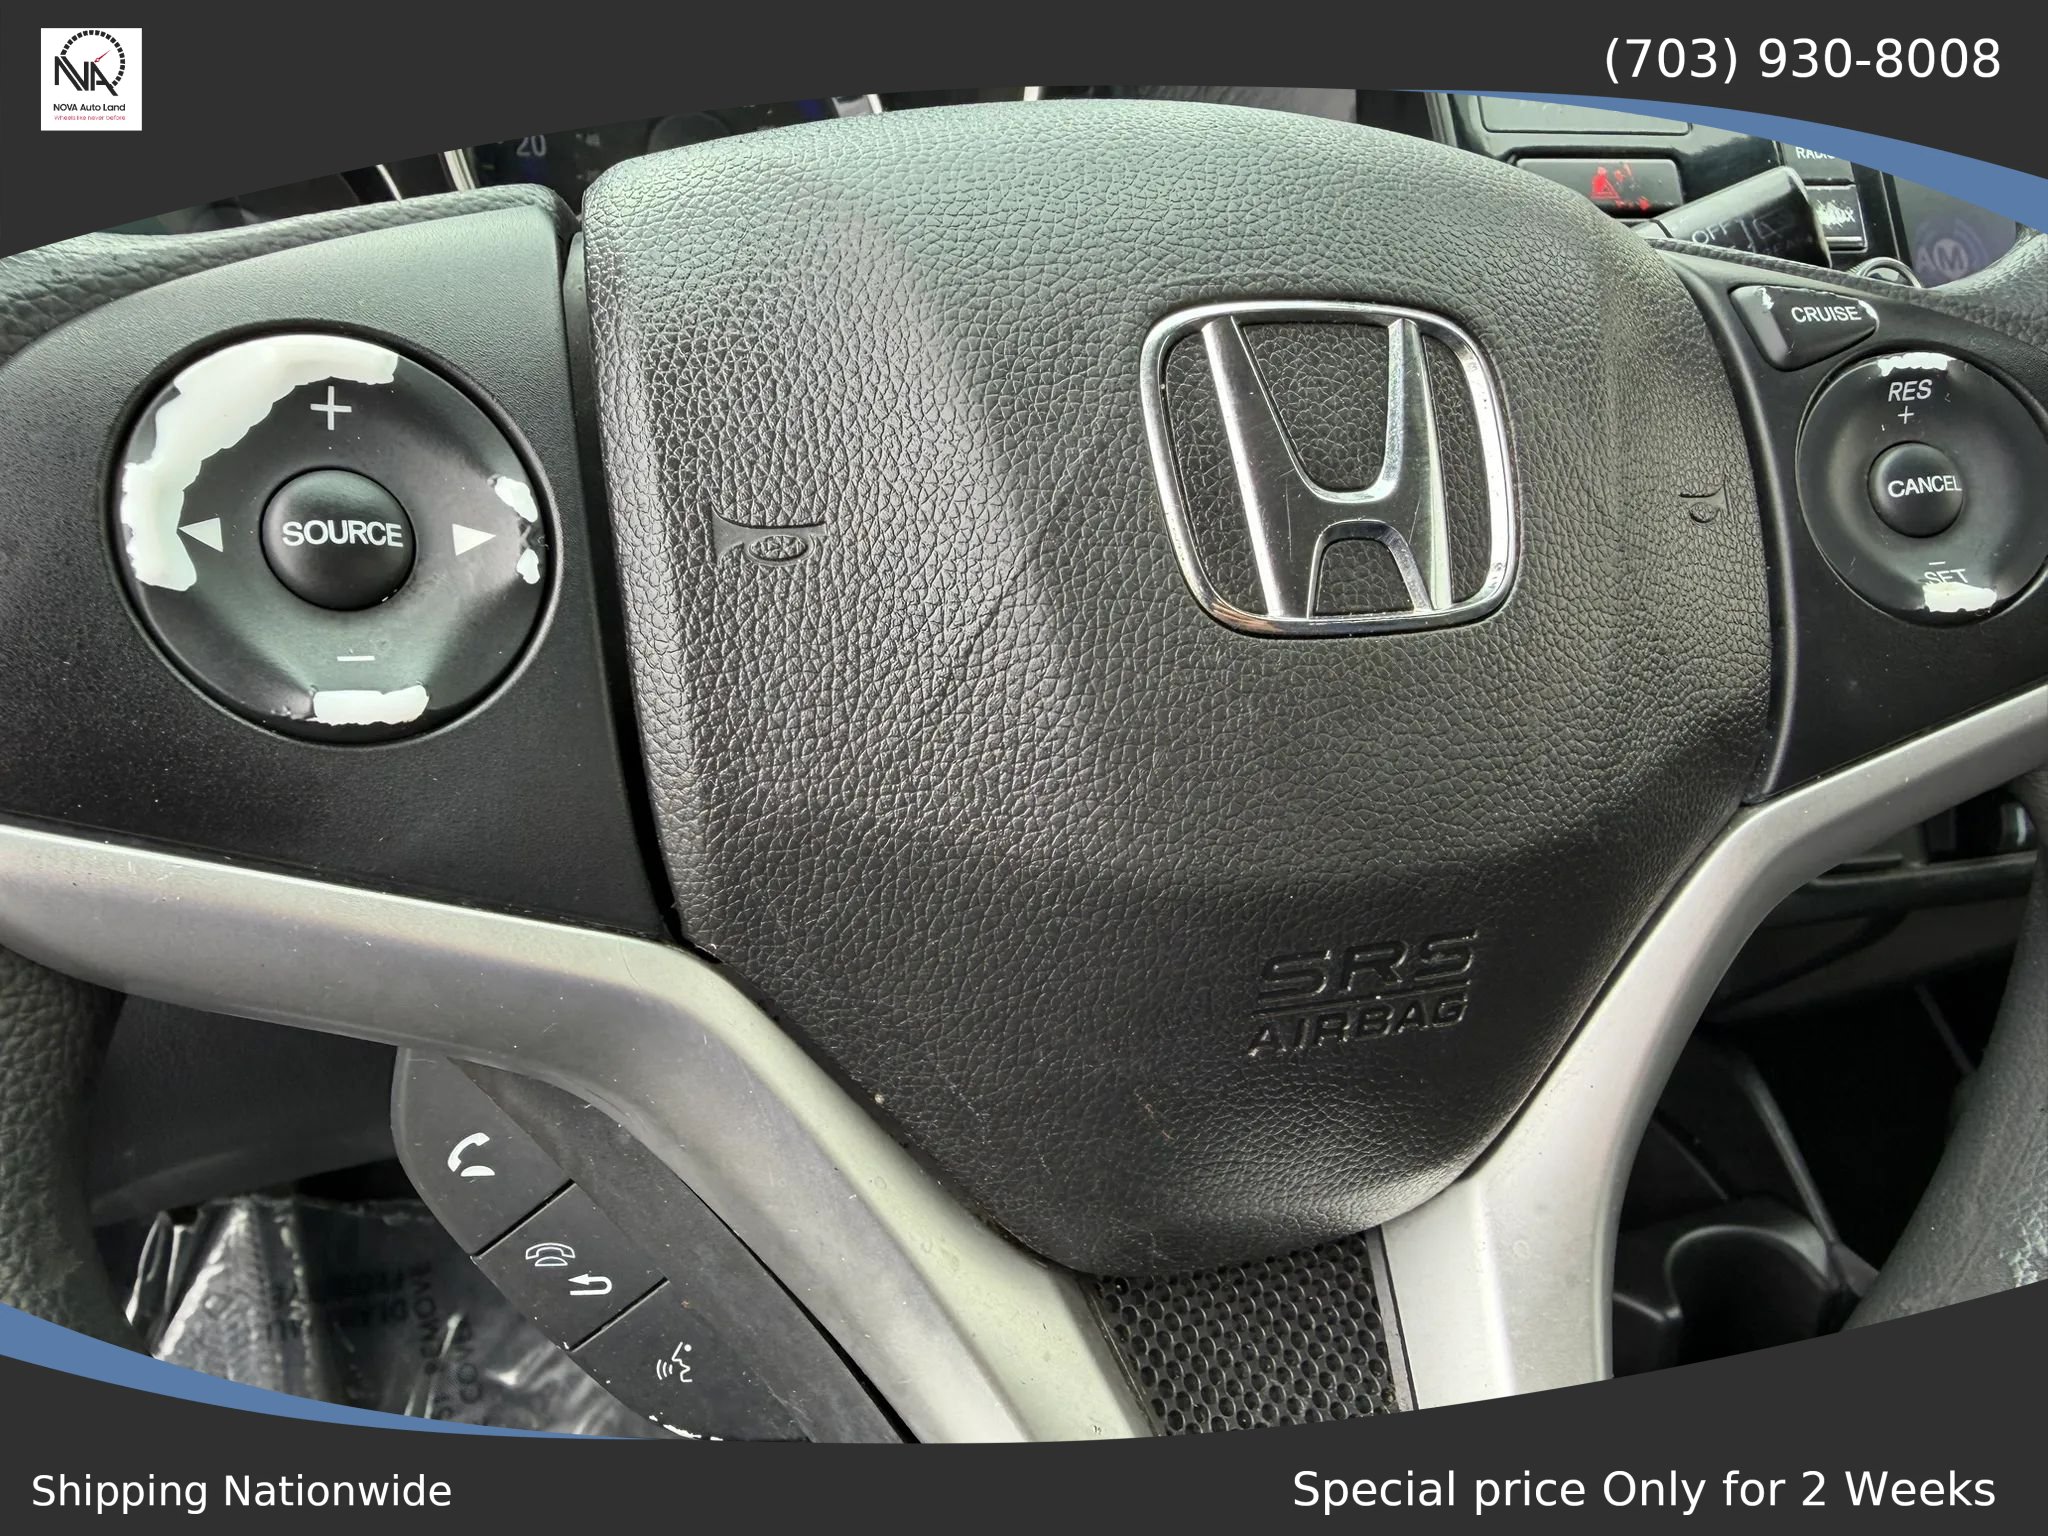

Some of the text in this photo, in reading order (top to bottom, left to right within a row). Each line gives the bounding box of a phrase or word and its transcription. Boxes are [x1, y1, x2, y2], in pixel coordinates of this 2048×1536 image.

[516, 134, 547, 157] 20
[1791, 306, 1862, 323] CRUISE
[1887, 378, 1934, 402] RES
[1887, 475, 1963, 499] CANCEL
[282, 519, 404, 548] SOURCE
[1257, 929, 1479, 1003] SRS
[1248, 993, 1469, 1057] AIRBAG
